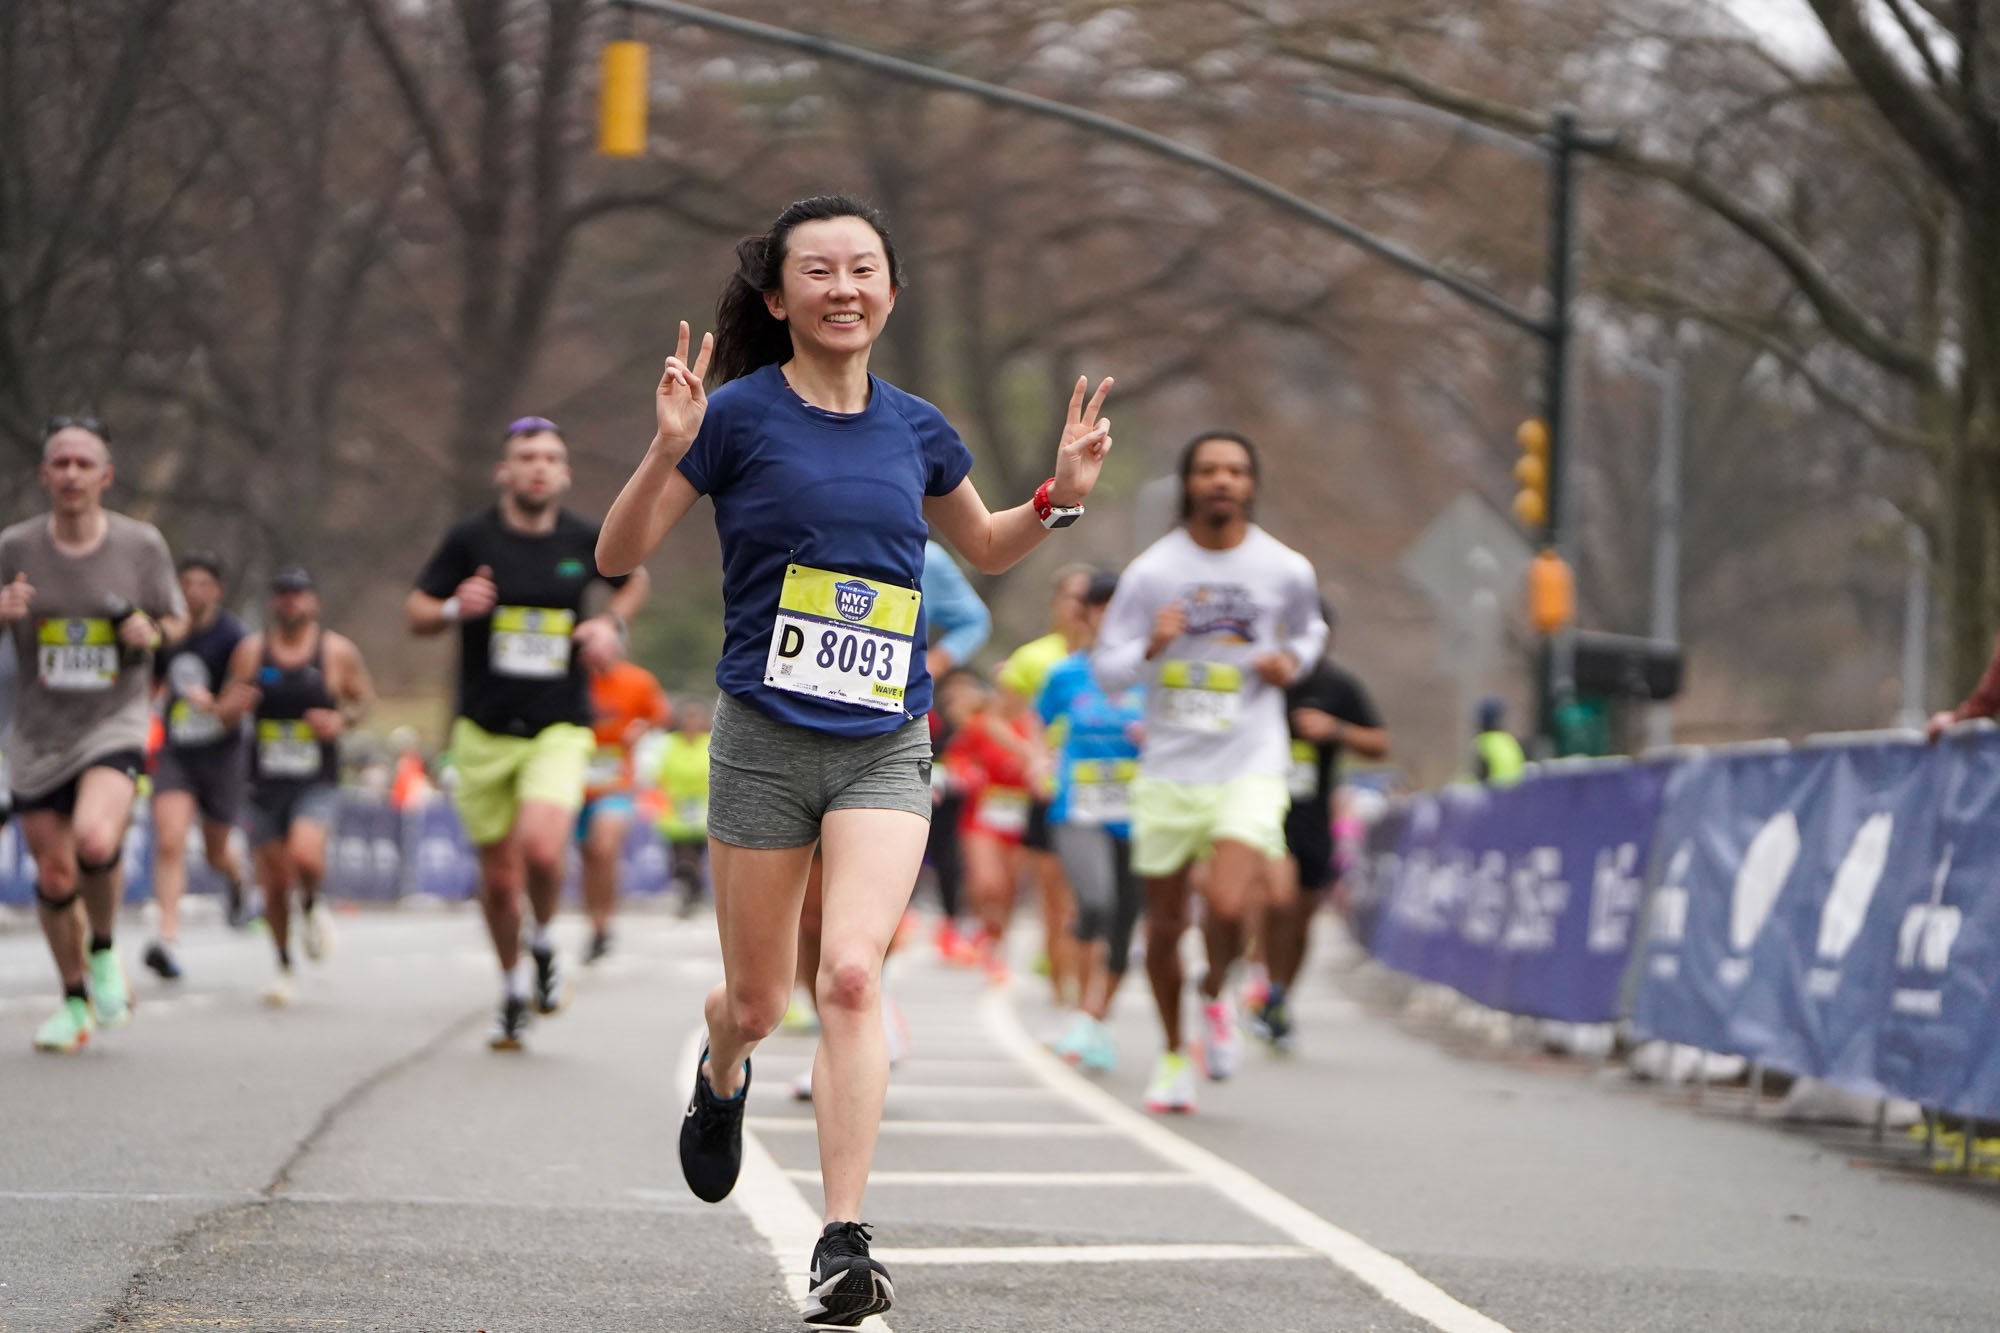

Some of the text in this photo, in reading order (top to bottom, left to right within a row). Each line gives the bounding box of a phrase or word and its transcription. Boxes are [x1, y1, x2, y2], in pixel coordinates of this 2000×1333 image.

[841, 591, 869, 608] NYC
[841, 604, 865, 615] HALF
[778, 624, 804, 658] D
[816, 630, 894, 681] 8093
[875, 684, 898, 697] WAVE
